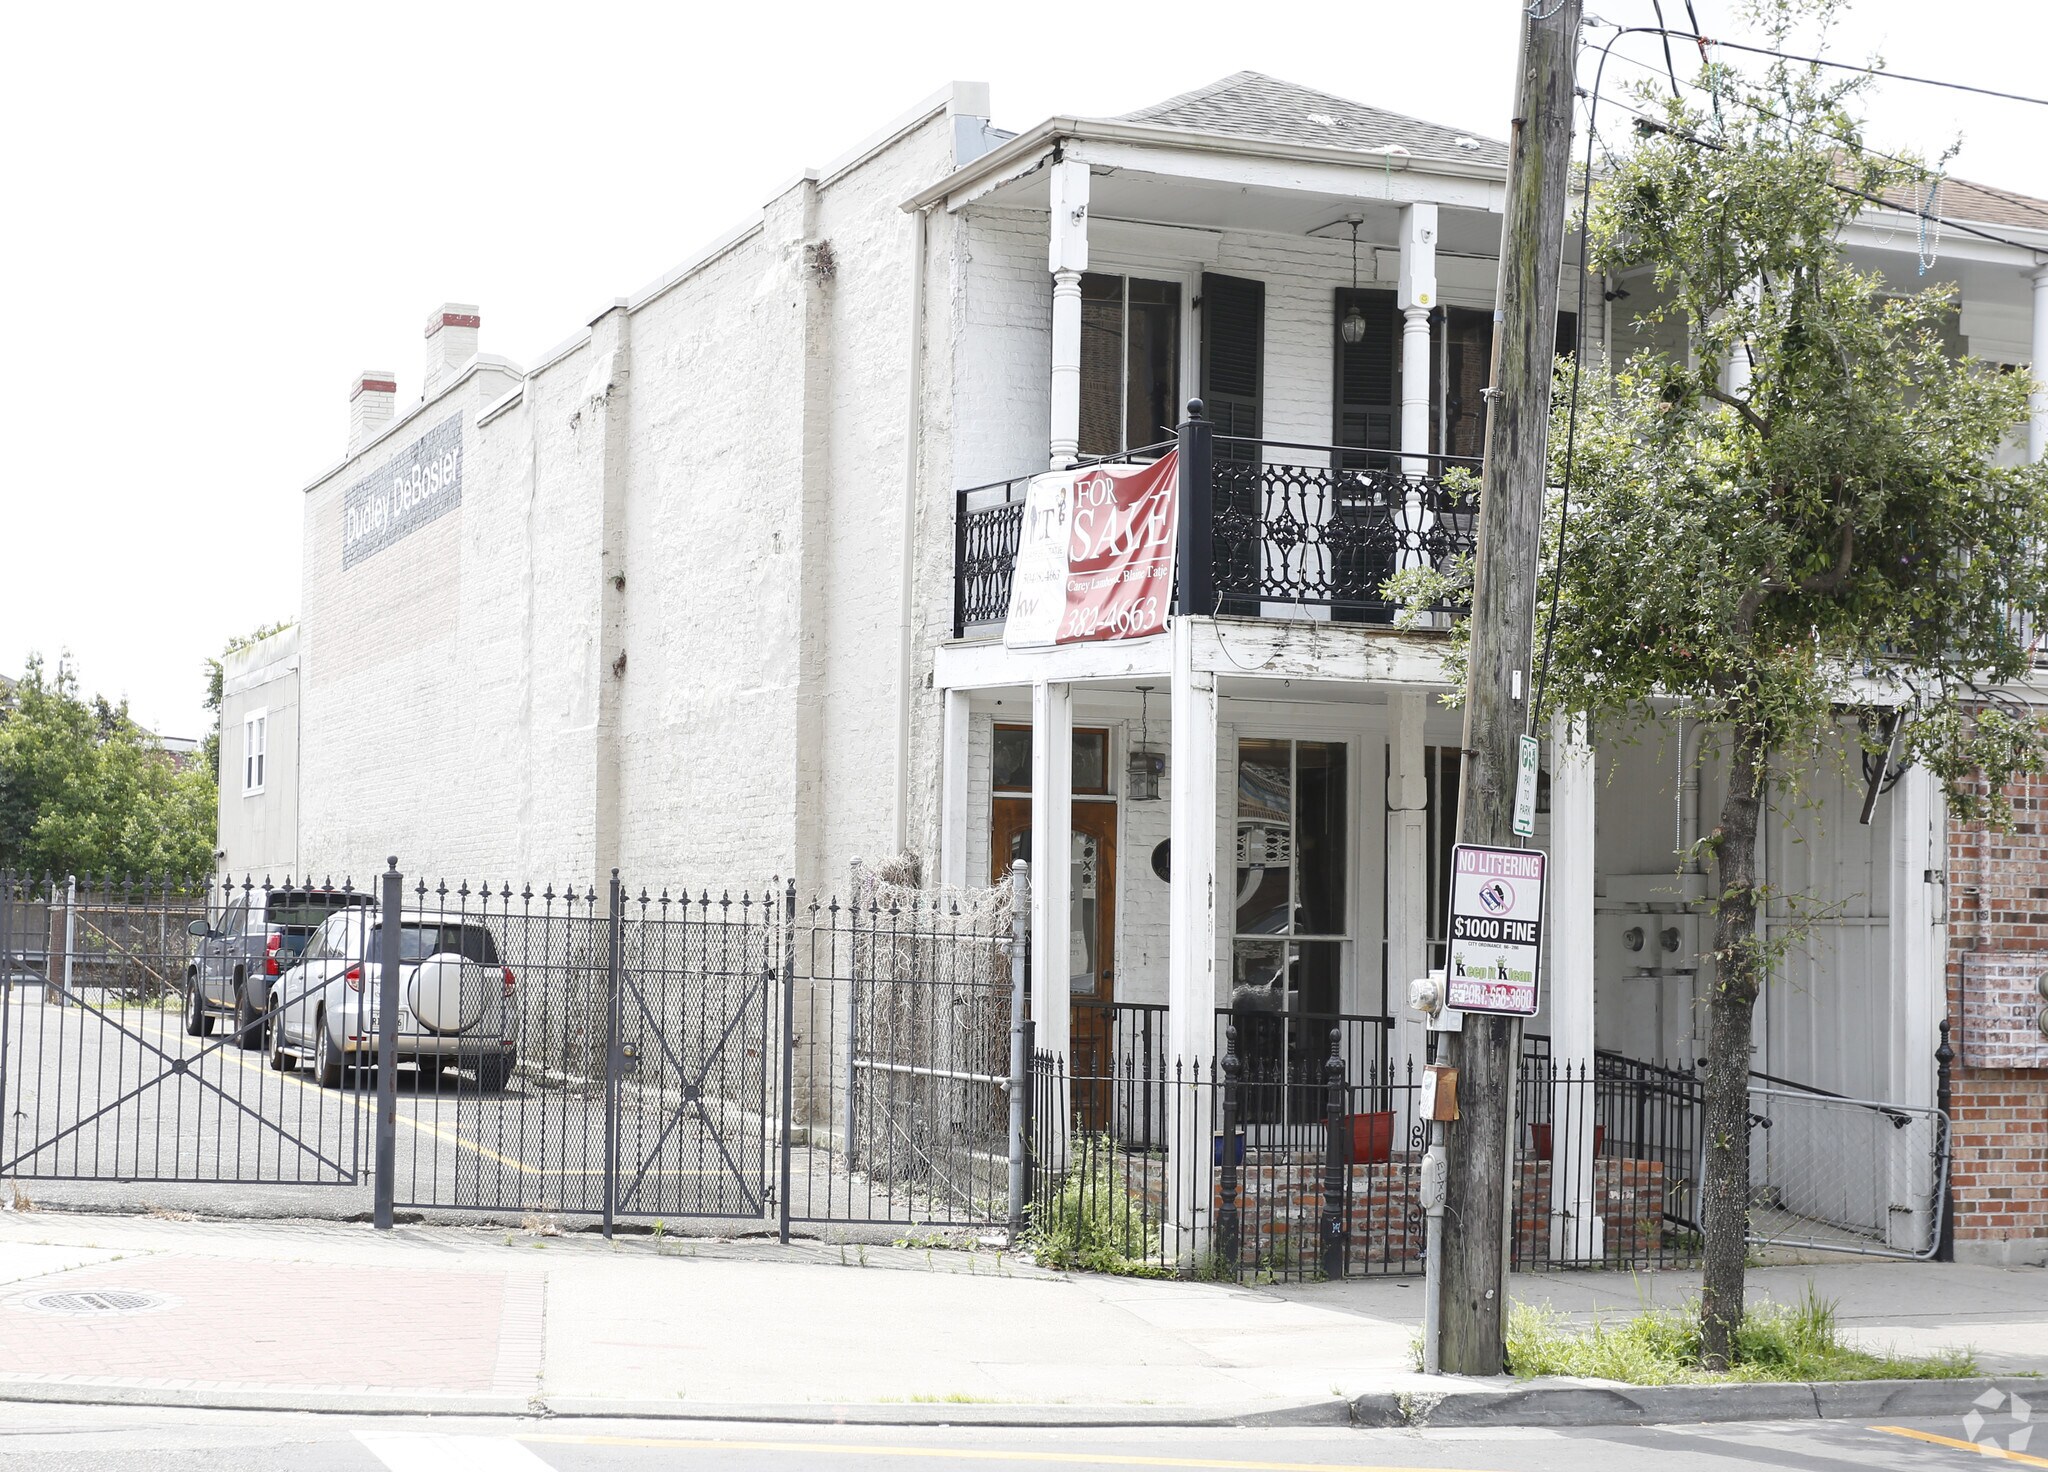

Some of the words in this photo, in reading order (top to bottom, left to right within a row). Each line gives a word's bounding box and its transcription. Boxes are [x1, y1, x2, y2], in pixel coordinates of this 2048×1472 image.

[346, 492, 391, 545] Dudley
[393, 447, 460, 518] DeBosier
[1076, 477, 1117, 508] FOR
[1069, 489, 1171, 562] SALE
[1067, 579, 1090, 594] Carey
[1147, 563, 1168, 580] Tatje
[1062, 596, 1157, 638] 382-4663
[1519, 803, 1531, 816] PARK
[1459, 851, 1476, 871] NO
[1479, 854, 1539, 878] LITTERING
[1454, 916, 1499, 939] $1000
[1503, 921, 1536, 942] FINE
[1478, 942, 1502, 950] ORDINANCE
[1455, 963, 1487, 979] Keep
[1498, 967, 1532, 982] Klean
